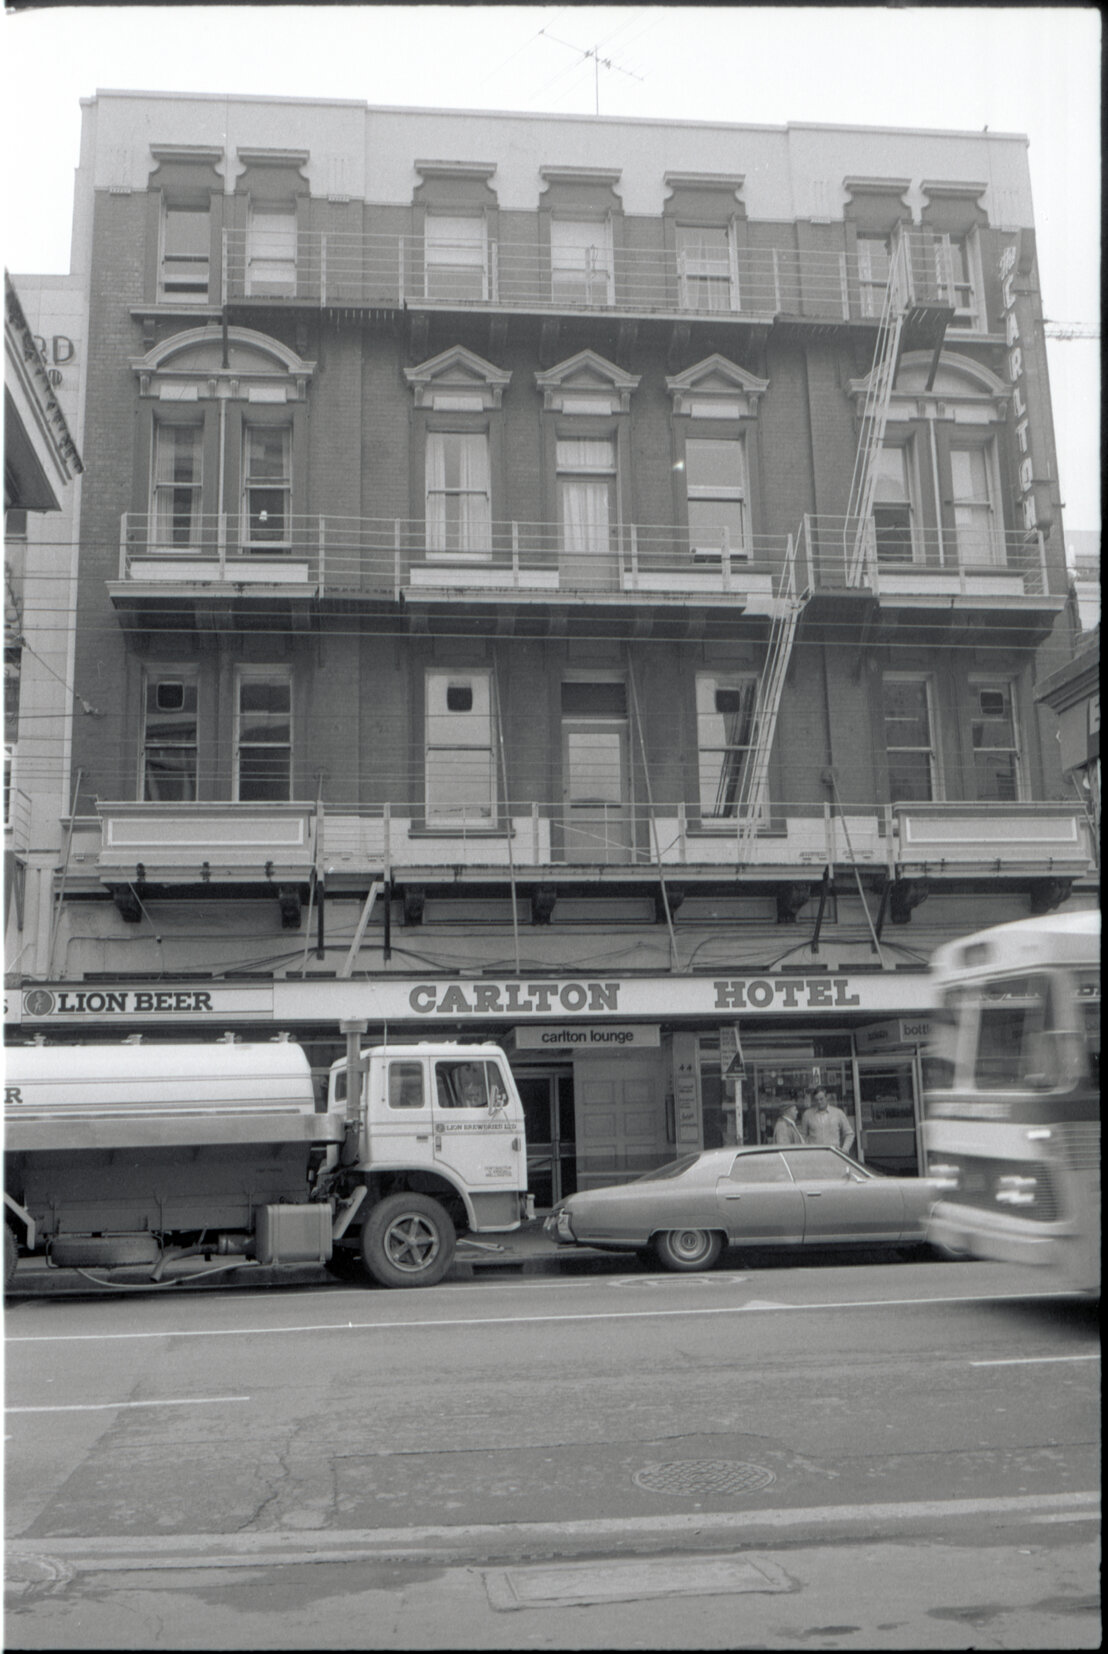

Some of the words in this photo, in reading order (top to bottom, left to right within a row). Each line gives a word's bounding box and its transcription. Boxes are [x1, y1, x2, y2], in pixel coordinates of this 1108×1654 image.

[57, 992, 128, 1013] LION
[134, 991, 213, 1012] BEER
[409, 983, 621, 1013] CARLTON
[714, 979, 860, 1008] HOTEL
[541, 1029, 587, 1043] carlton
[590, 1029, 634, 1044] lounge
